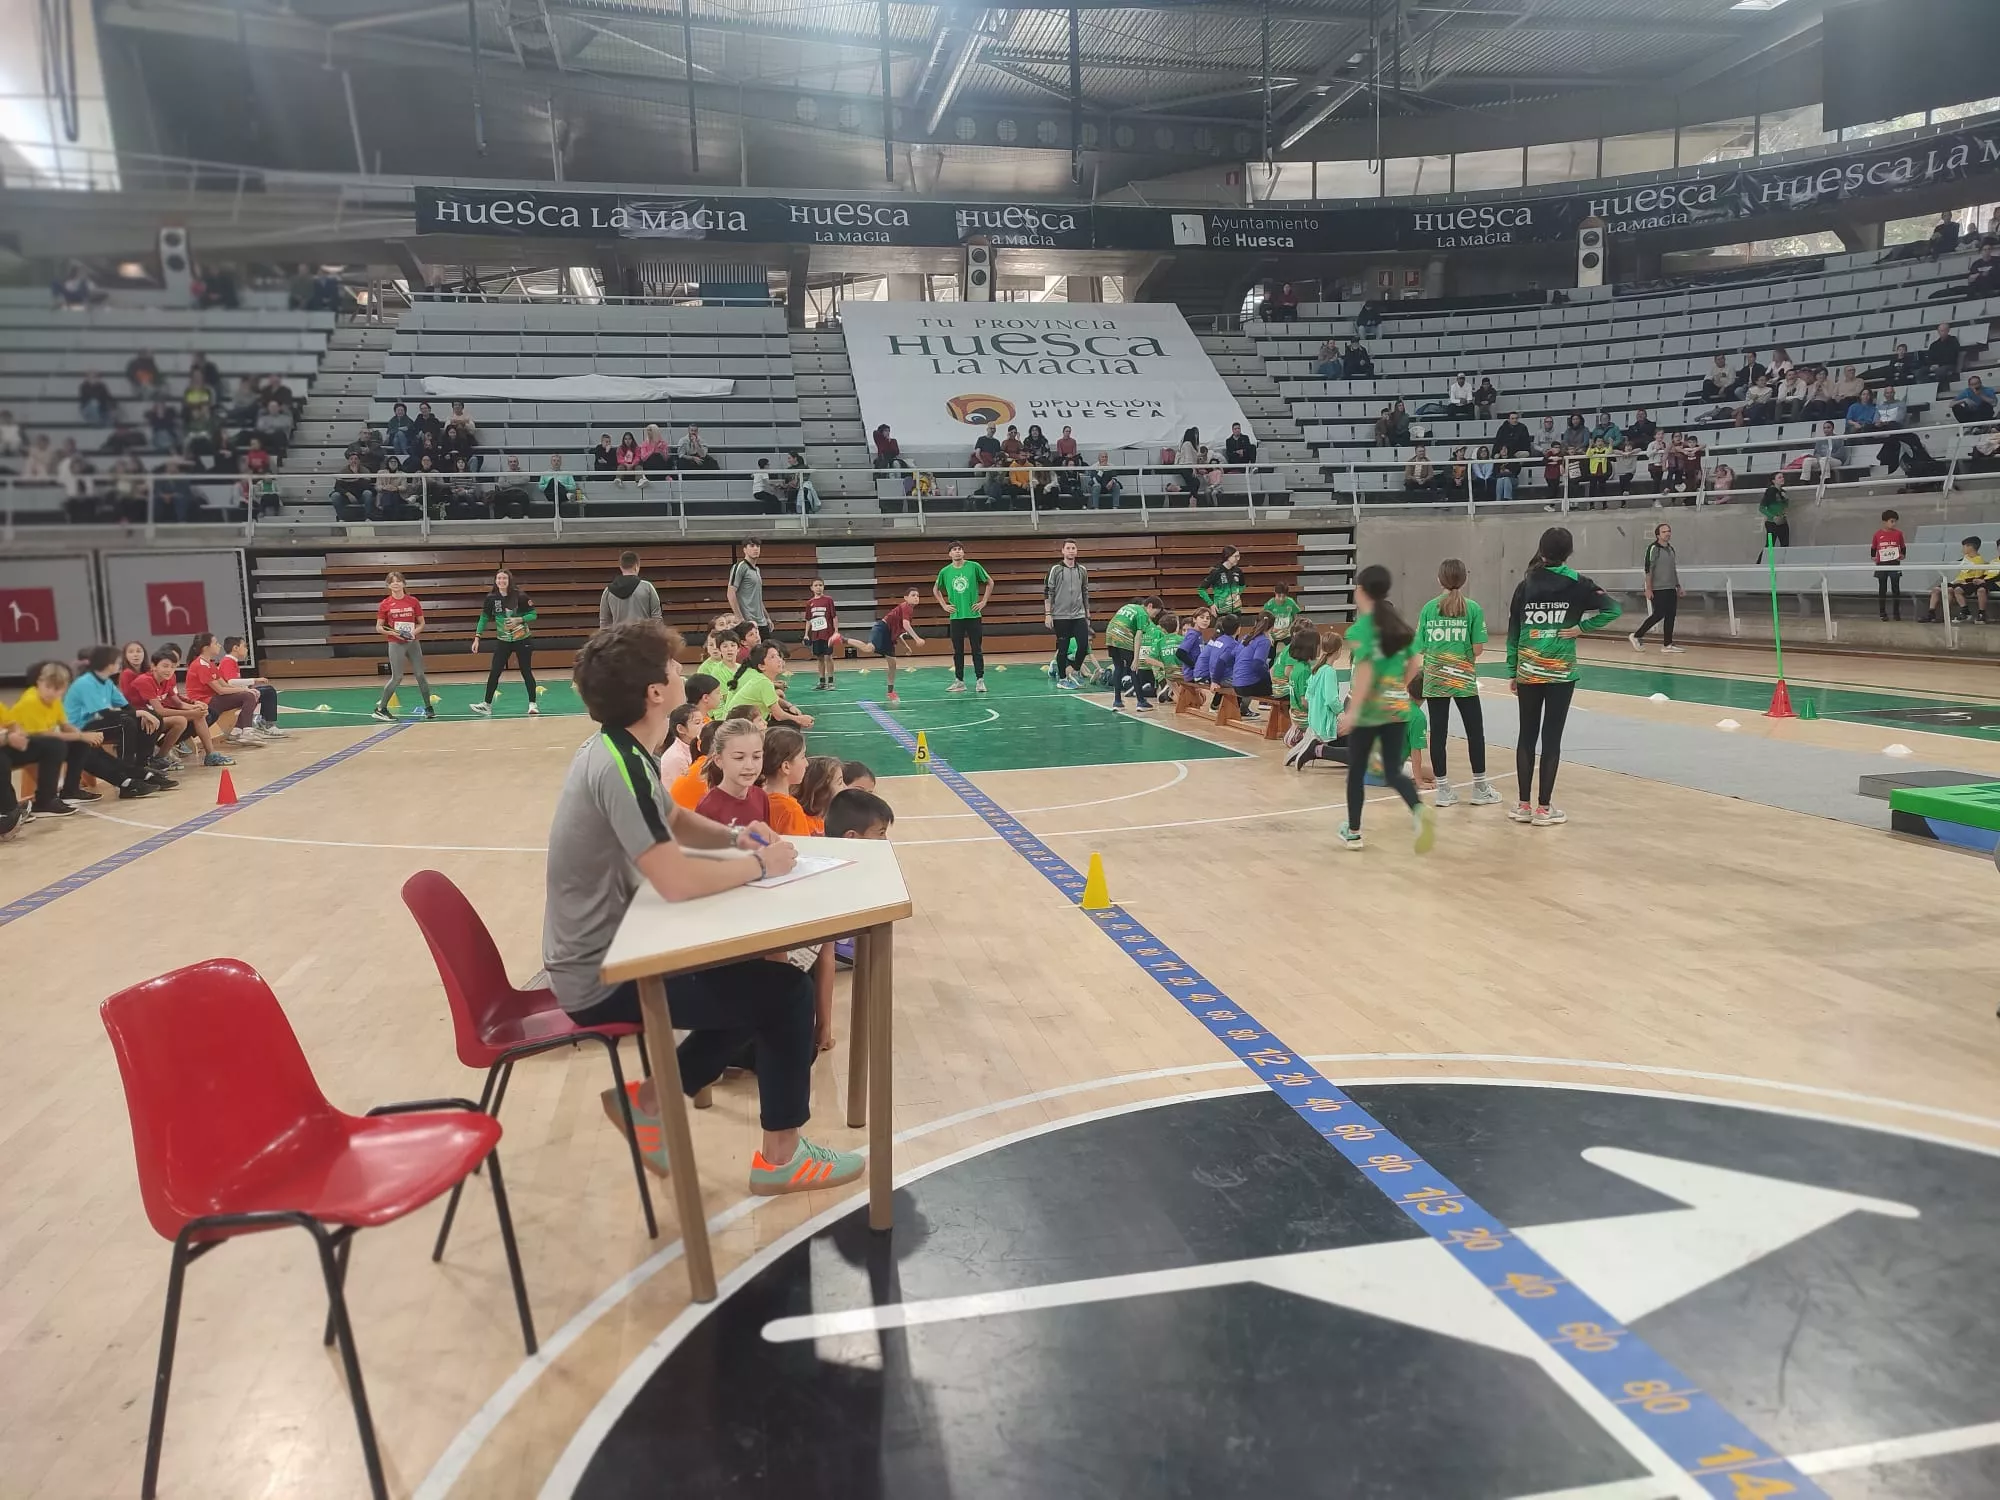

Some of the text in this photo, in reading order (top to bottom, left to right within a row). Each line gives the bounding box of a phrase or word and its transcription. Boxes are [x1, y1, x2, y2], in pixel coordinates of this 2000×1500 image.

[1211, 215, 1319, 233] Ayuntamiento
[1212, 233, 1294, 248] de Huesca
[1032, 410, 1167, 419] HUESCA
[917, 746, 926, 759] 5
[1206, 1010, 1237, 1021] 60
[1227, 1029, 1260, 1041] 80
[1248, 1048, 1291, 1067] 12
[1274, 1072, 1312, 1087] 20
[1305, 1098, 1342, 1112] 40
[1333, 1124, 1375, 1141] 60
[1368, 1155, 1413, 1173] 80
[1403, 1187, 1464, 1216] 13
[1448, 1228, 1503, 1251] 20
[1505, 1272, 1557, 1298] 40
[1557, 1322, 1619, 1352] 60
[1623, 1380, 1691, 1414] 80
